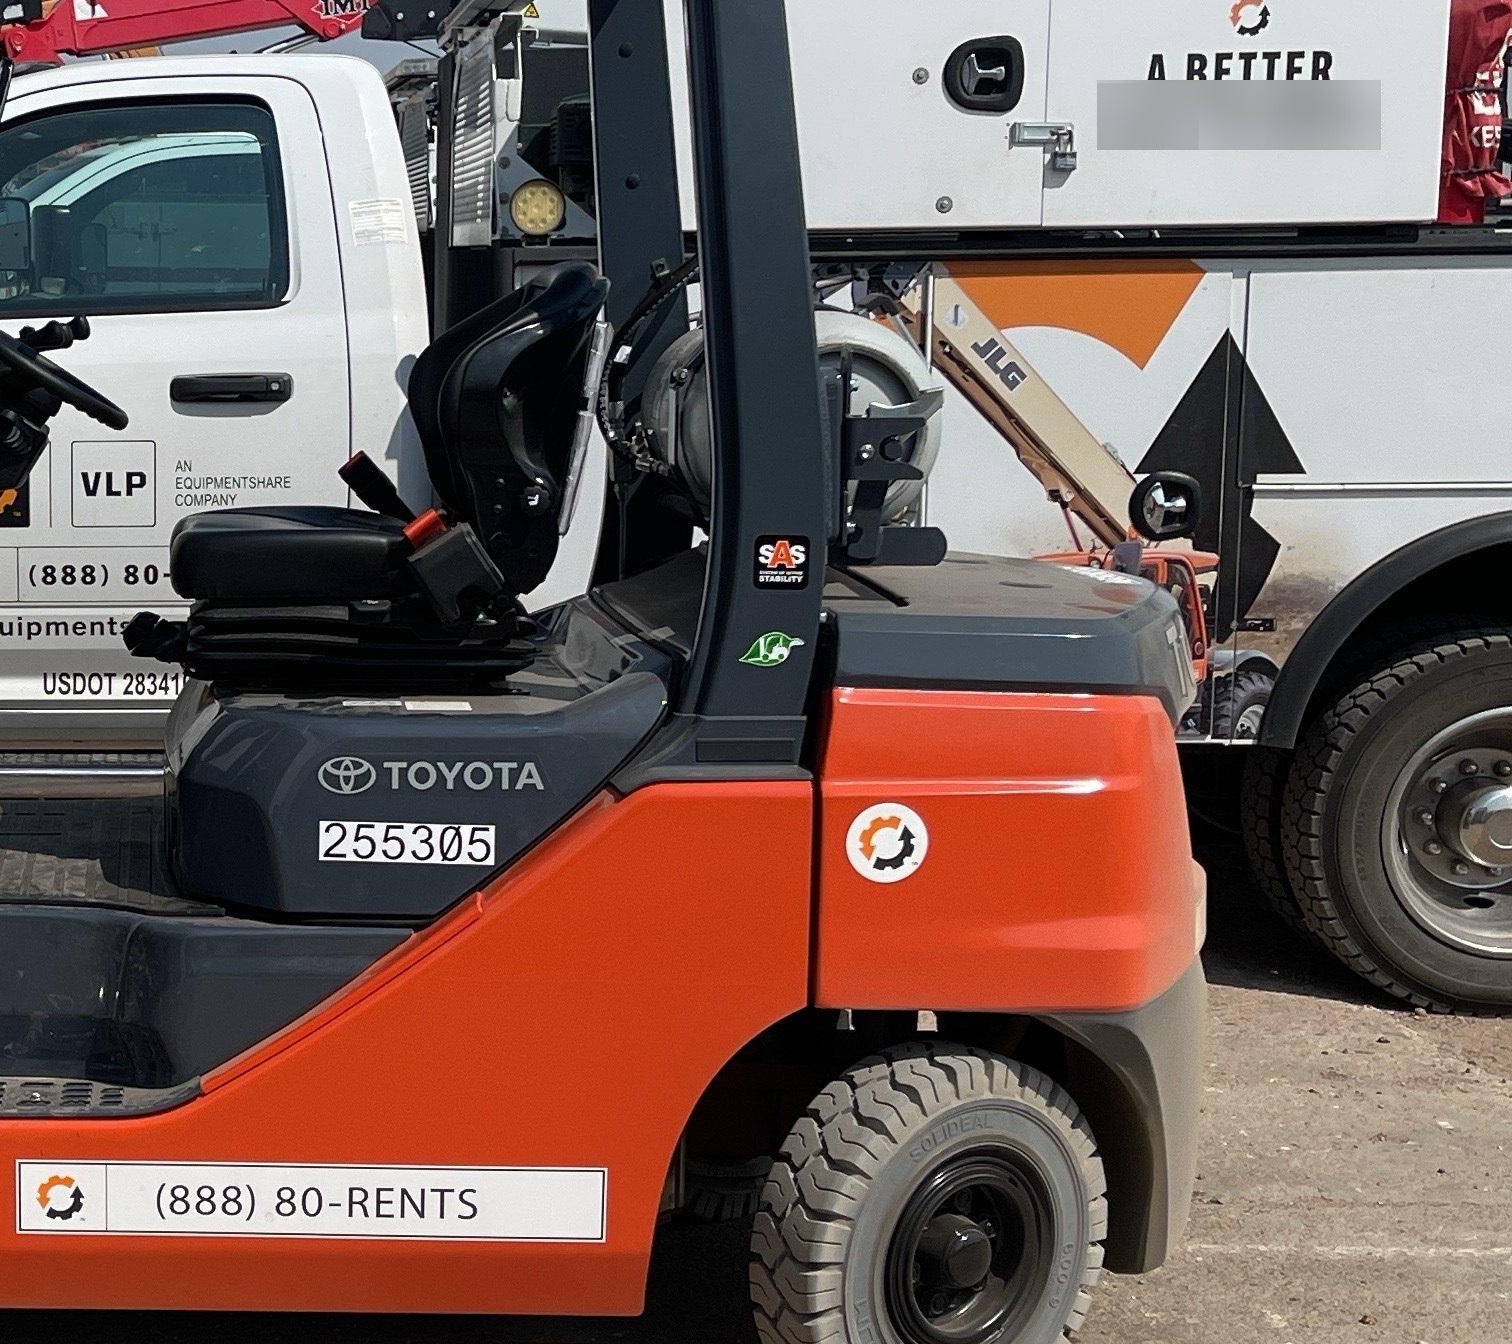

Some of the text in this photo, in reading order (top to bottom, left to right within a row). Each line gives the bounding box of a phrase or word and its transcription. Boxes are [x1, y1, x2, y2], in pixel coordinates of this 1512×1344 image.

[1147, 50, 1334, 81] A BETTER
[970, 337, 1028, 392] JLG
[175, 459, 193, 472] AN
[80, 471, 147, 497] VLP
[175, 476, 292, 490] EQUIPMENTSHARE
[175, 493, 238, 506] COMPANY
[758, 540, 806, 568] SAS
[29, 563, 109, 587] (888)
[43, 672, 117, 695] USDOT
[383, 760, 545, 791] TOYOTA
[322, 821, 492, 863] 255305
[909, 1113, 993, 1163] SOLIDEAL
[155, 1182, 479, 1221] (888) 80-RENTS
